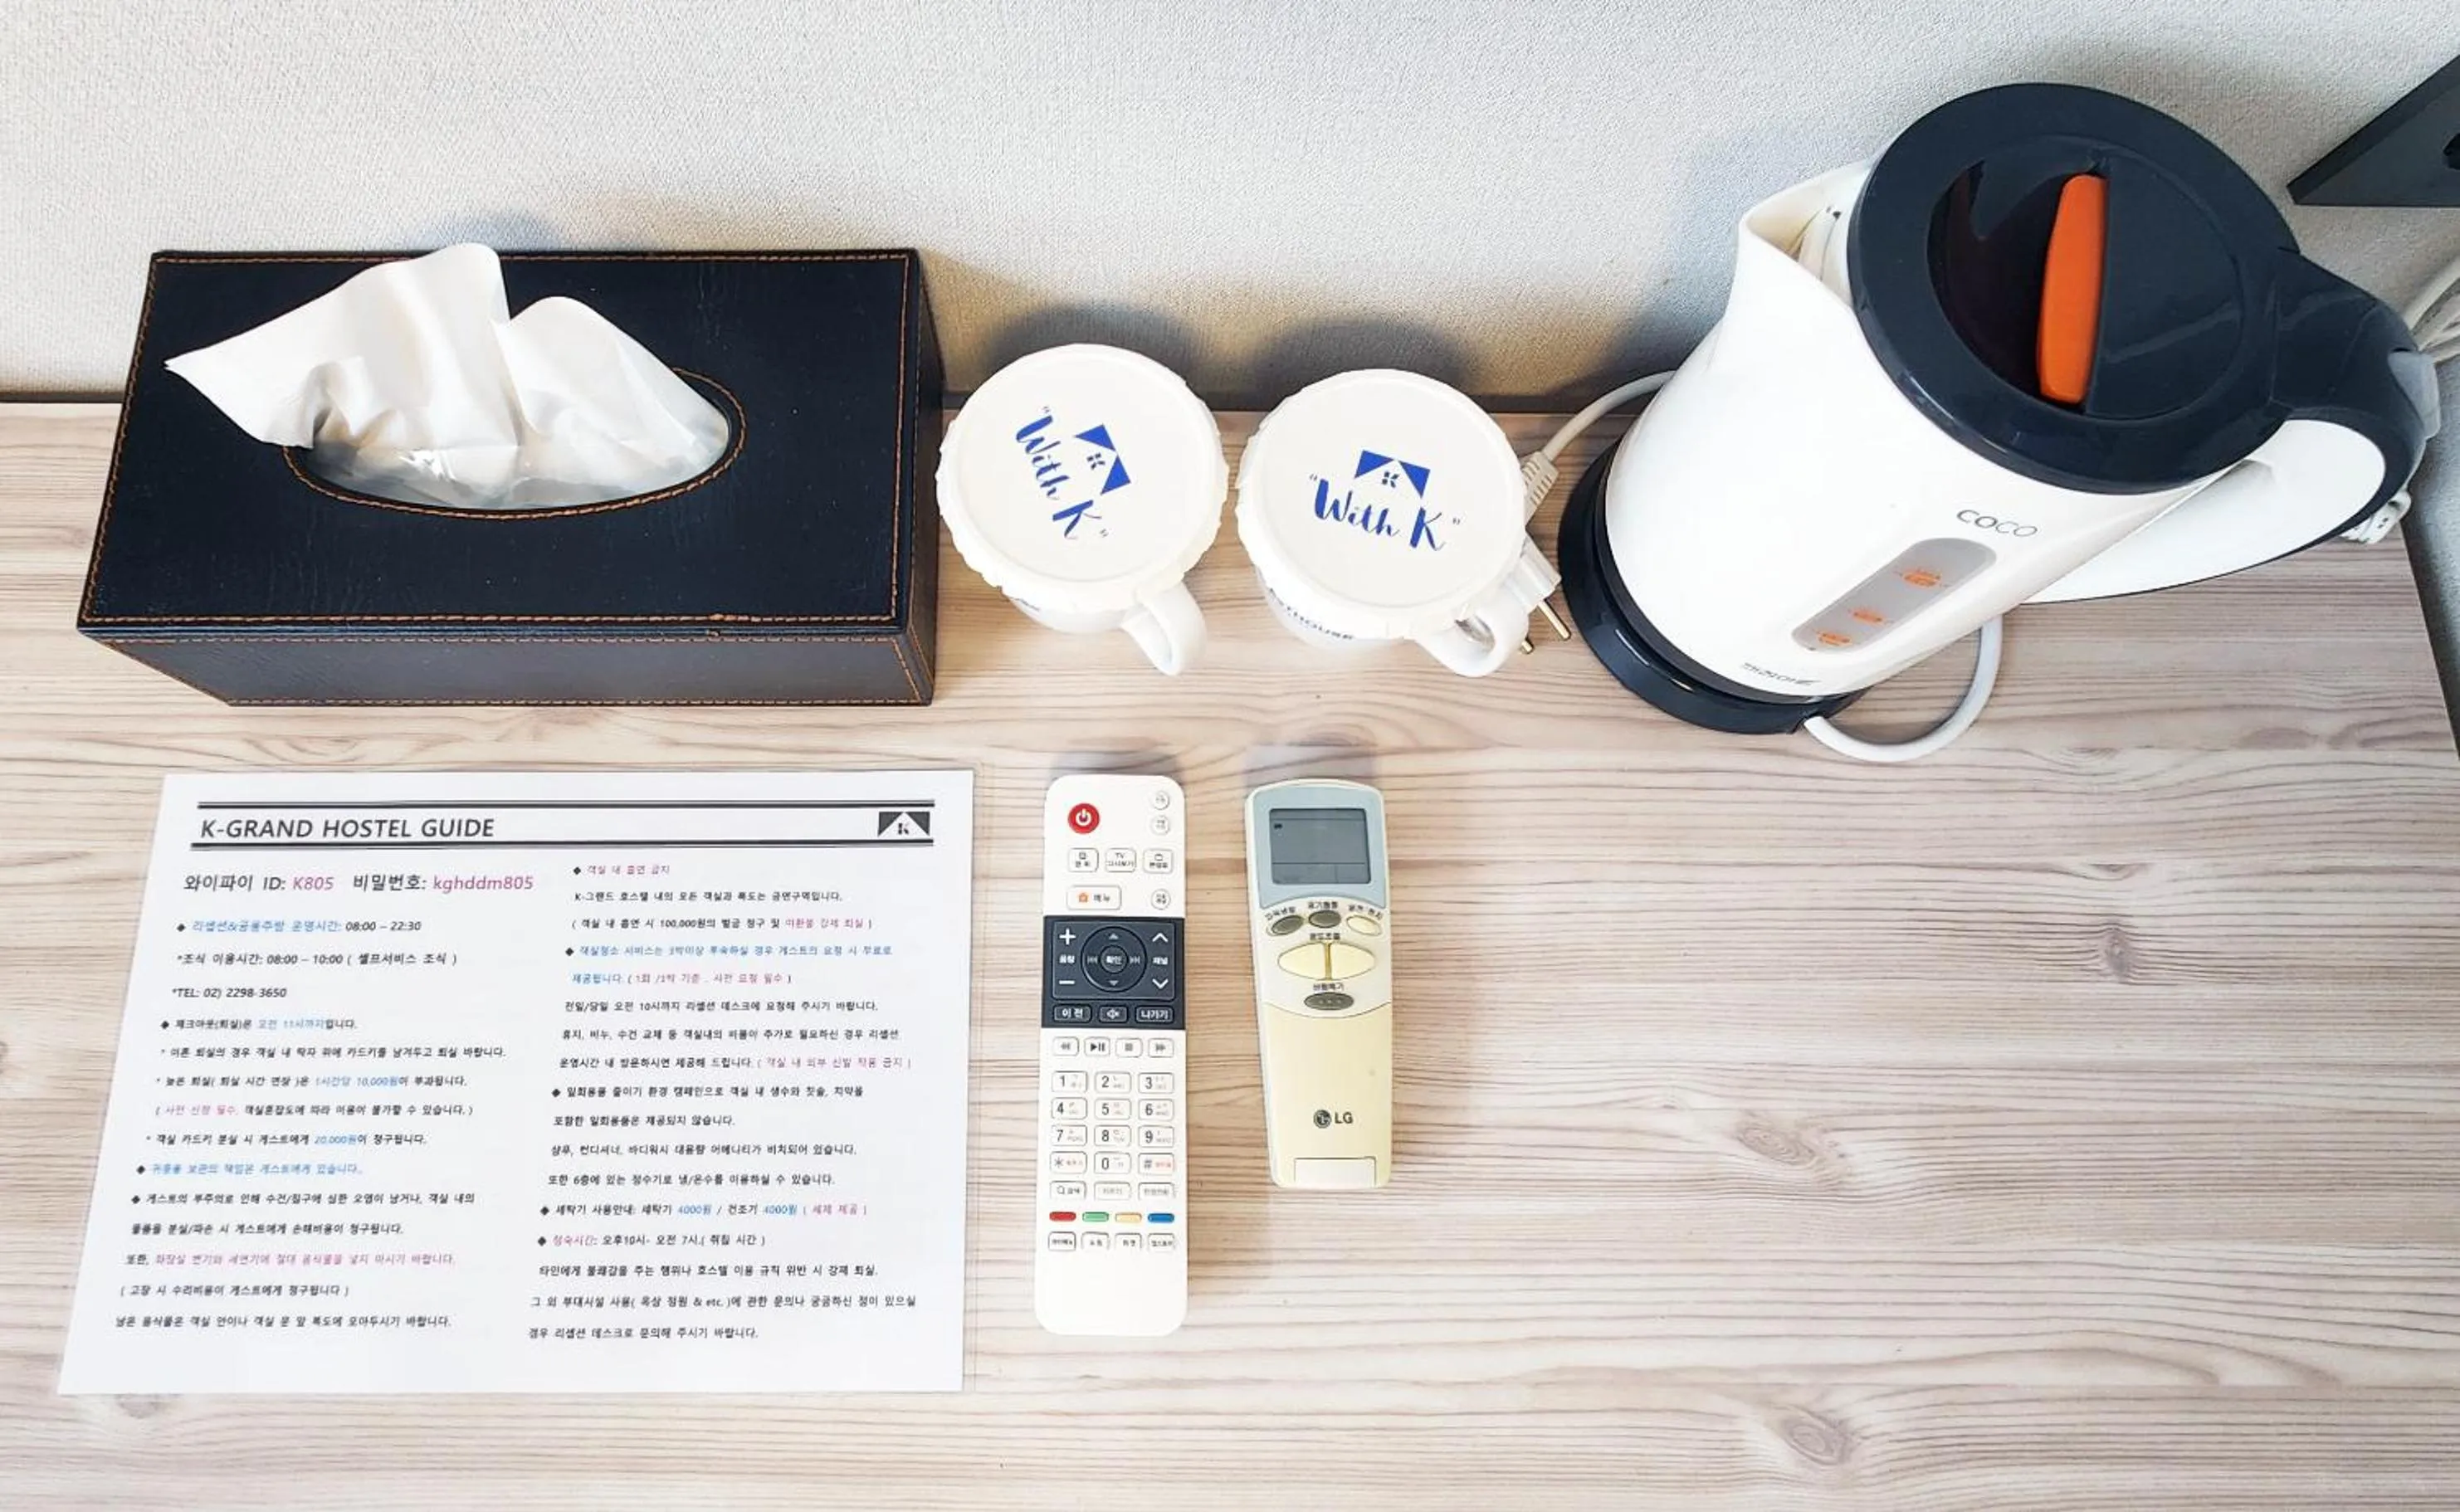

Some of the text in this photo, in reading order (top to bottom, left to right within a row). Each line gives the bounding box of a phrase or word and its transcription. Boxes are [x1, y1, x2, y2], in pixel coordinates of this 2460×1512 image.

[200, 818, 495, 839] K-GRAND HOSTEL GUIDE
[896, 821, 910, 836] K
[183, 874, 534, 895] 와이파이 ID: K805 비밀번호: kghddm805
[344, 920, 377, 932] 08:00
[389, 920, 422, 932] 22:30
[212, 952, 264, 966] 이용시간:
[266, 954, 299, 965] 08:00
[311, 954, 344, 965] 10:00
[357, 952, 417, 965] 셀프서비스
[1106, 955, 1122, 965] 확인
[203, 988, 222, 1000] 02)
[1140, 1009, 1169, 1019] 나가기
[1060, 1075, 1066, 1087] 1
[1101, 1075, 1110, 1088] 2
[1145, 1076, 1153, 1090] 3
[1057, 1102, 1064, 1115] 4
[1101, 1103, 1110, 1115] 5
[1145, 1103, 1154, 1116] 6
[1334, 1111, 1354, 1124] LG
[1057, 1129, 1064, 1142] 7
[1101, 1129, 1110, 1142] 8
[1145, 1129, 1154, 1144] 9
[1101, 1157, 1110, 1170] 0
[692, 1296, 703, 1307] &
